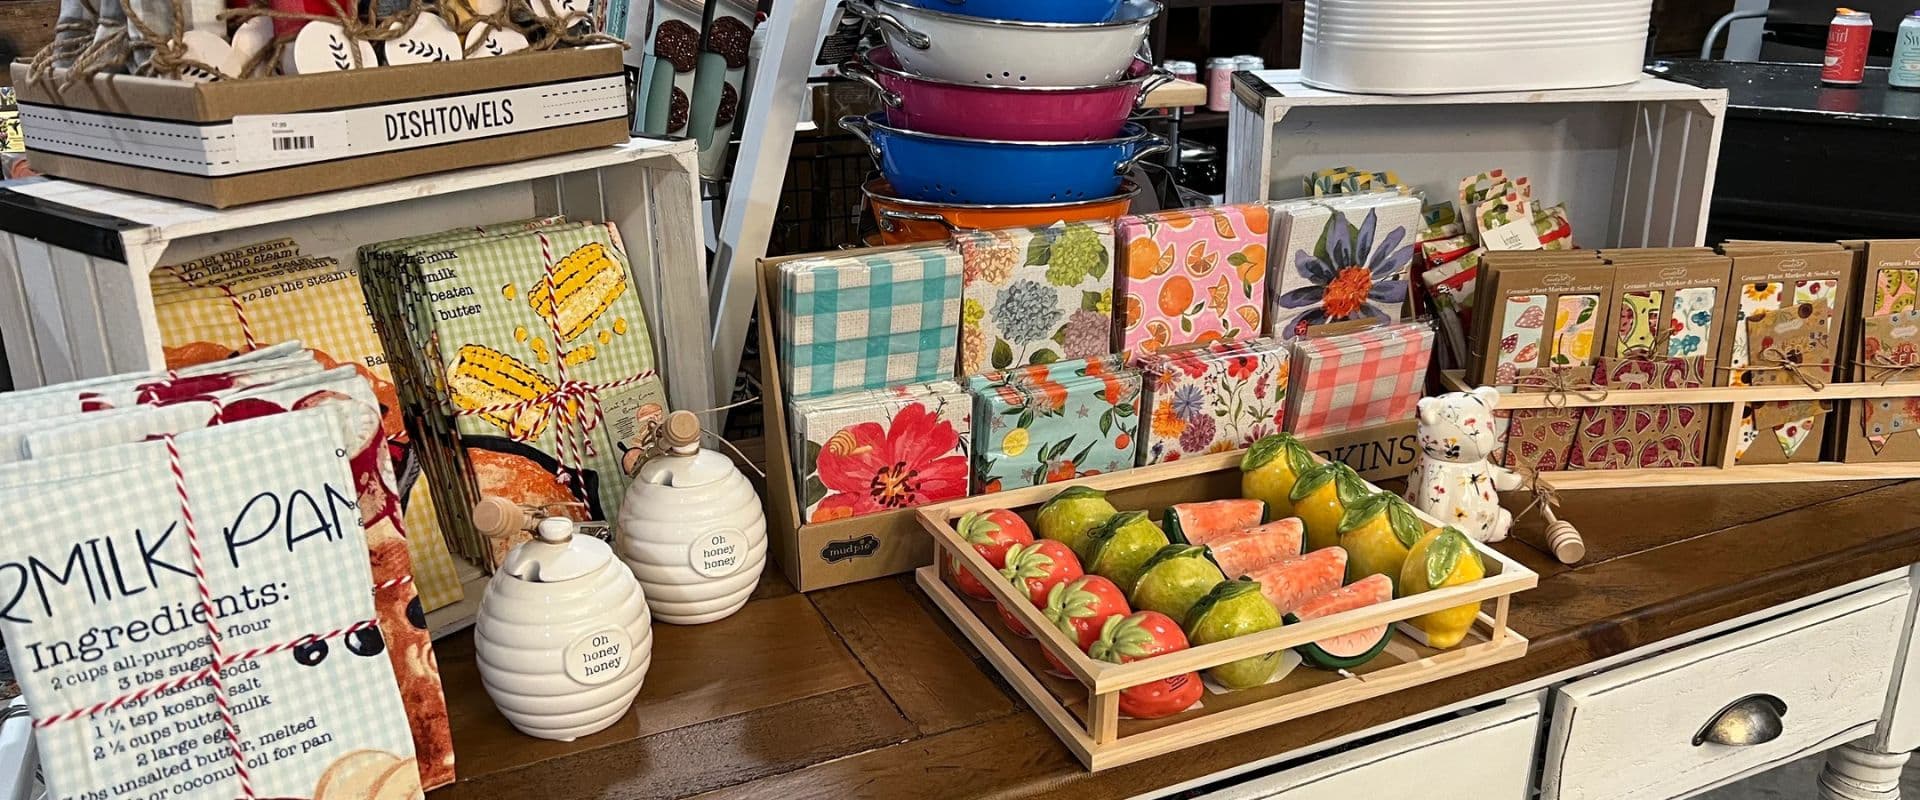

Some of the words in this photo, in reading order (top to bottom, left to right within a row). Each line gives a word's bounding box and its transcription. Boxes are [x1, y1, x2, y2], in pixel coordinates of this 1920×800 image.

[385, 99, 514, 141] DISHTOWELS
[254, 249, 291, 265] steam
[428, 249, 458, 264] milk
[260, 286, 279, 299] let
[281, 280, 304, 294] the
[307, 270, 348, 286] steam
[429, 286, 474, 302] beaten
[439, 304, 481, 320] butter
[703, 543, 736, 559] honey
[711, 535, 726, 546] Oh
[830, 539, 871, 557] mudpie
[704, 555, 736, 570] honey
[25, 582, 289, 673] Ingredients:
[592, 634, 609, 648] Oh
[51, 677, 62, 691] 2
[66, 664, 108, 685] cups
[227, 618, 271, 638] flour
[583, 642, 621, 664] honey
[219, 659, 260, 680] soda
[585, 656, 622, 677] honey
[118, 676, 131, 690] 3
[135, 668, 164, 686] tbs
[95, 726, 104, 739] 1
[129, 711, 158, 727] tsp
[162, 691, 219, 718] koshe
[228, 677, 262, 697] salt
[94, 746, 106, 760] 2
[129, 726, 171, 748] cups
[136, 753, 149, 767] 2
[151, 739, 198, 762] large
[112, 759, 192, 796] unsalted
[259, 716, 317, 746] melted
[173, 763, 239, 795] coconu
[247, 752, 270, 769] oil
[272, 744, 297, 761] for
[301, 731, 333, 753] pan
